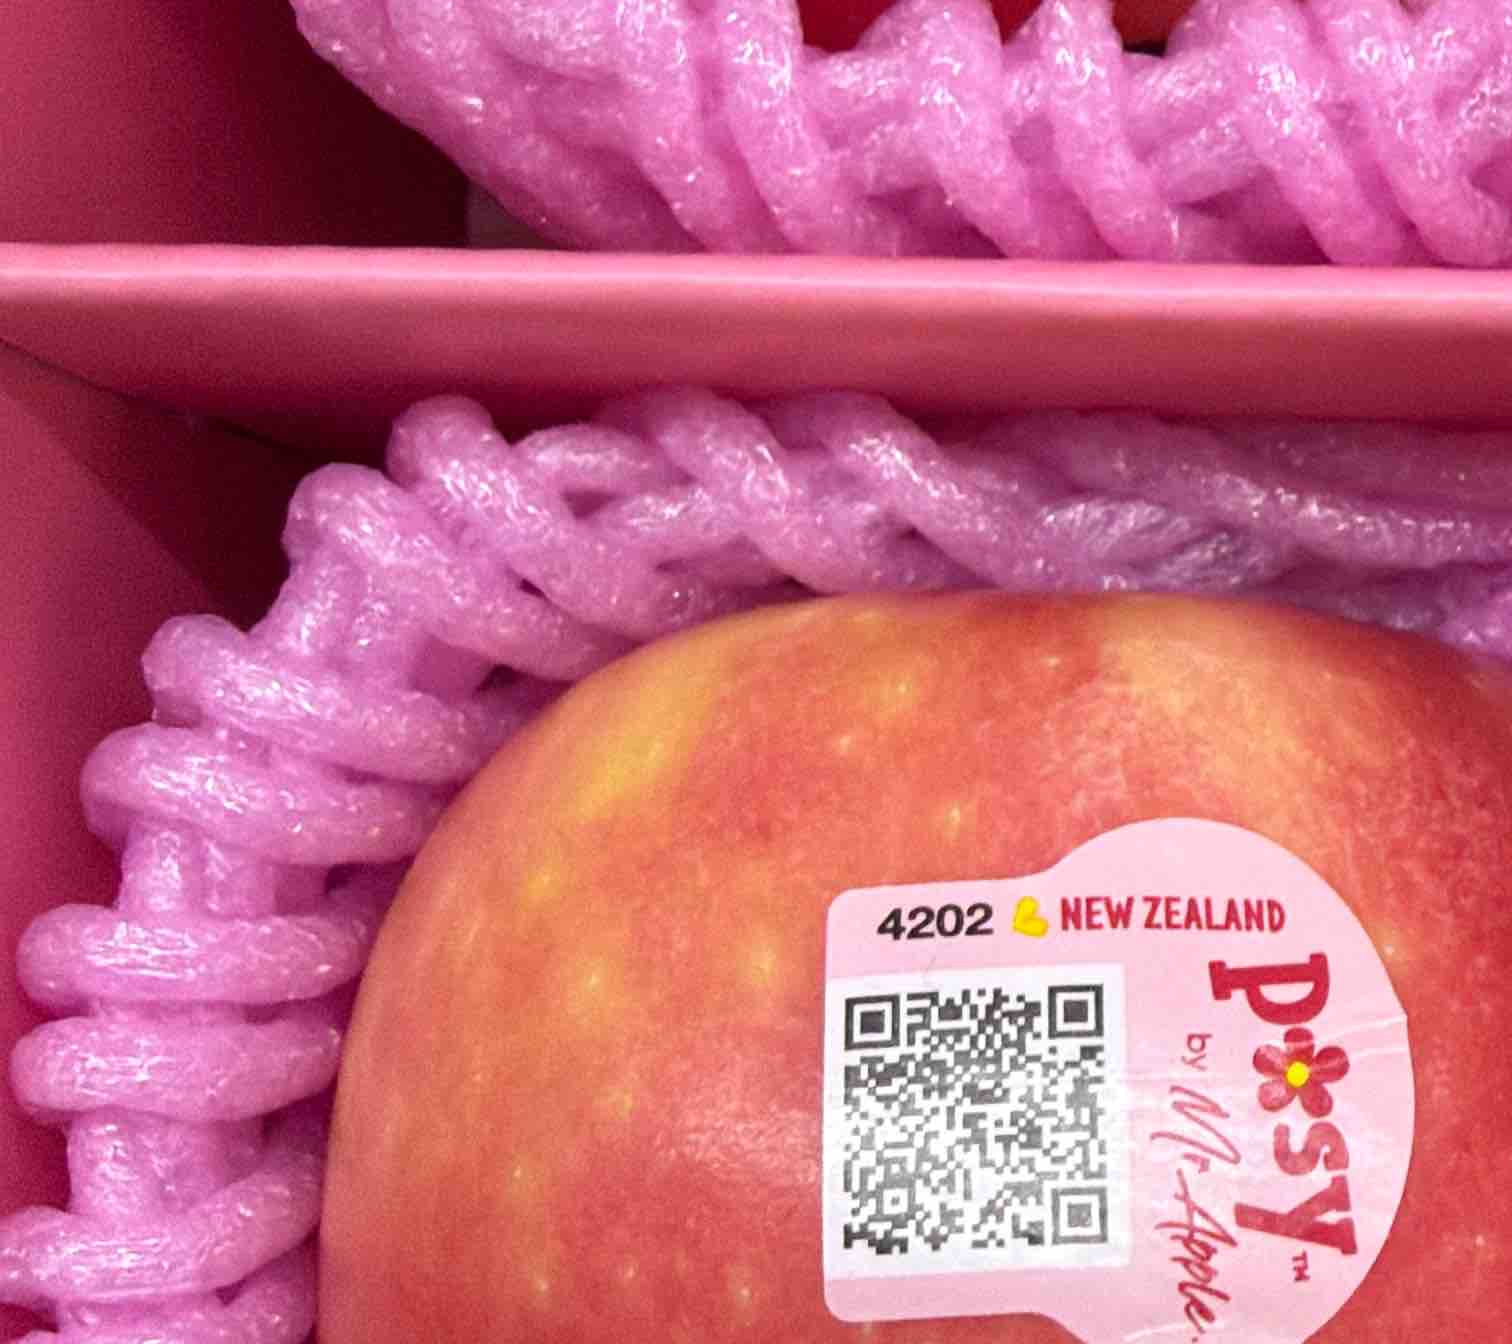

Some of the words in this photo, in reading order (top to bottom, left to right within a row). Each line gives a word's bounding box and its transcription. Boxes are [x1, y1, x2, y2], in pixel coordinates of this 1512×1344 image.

[876, 902, 994, 941] 4202
[1060, 896, 1135, 932] NEW
[1143, 895, 1287, 934] ZEALAND
[1181, 1032, 1213, 1072] by
